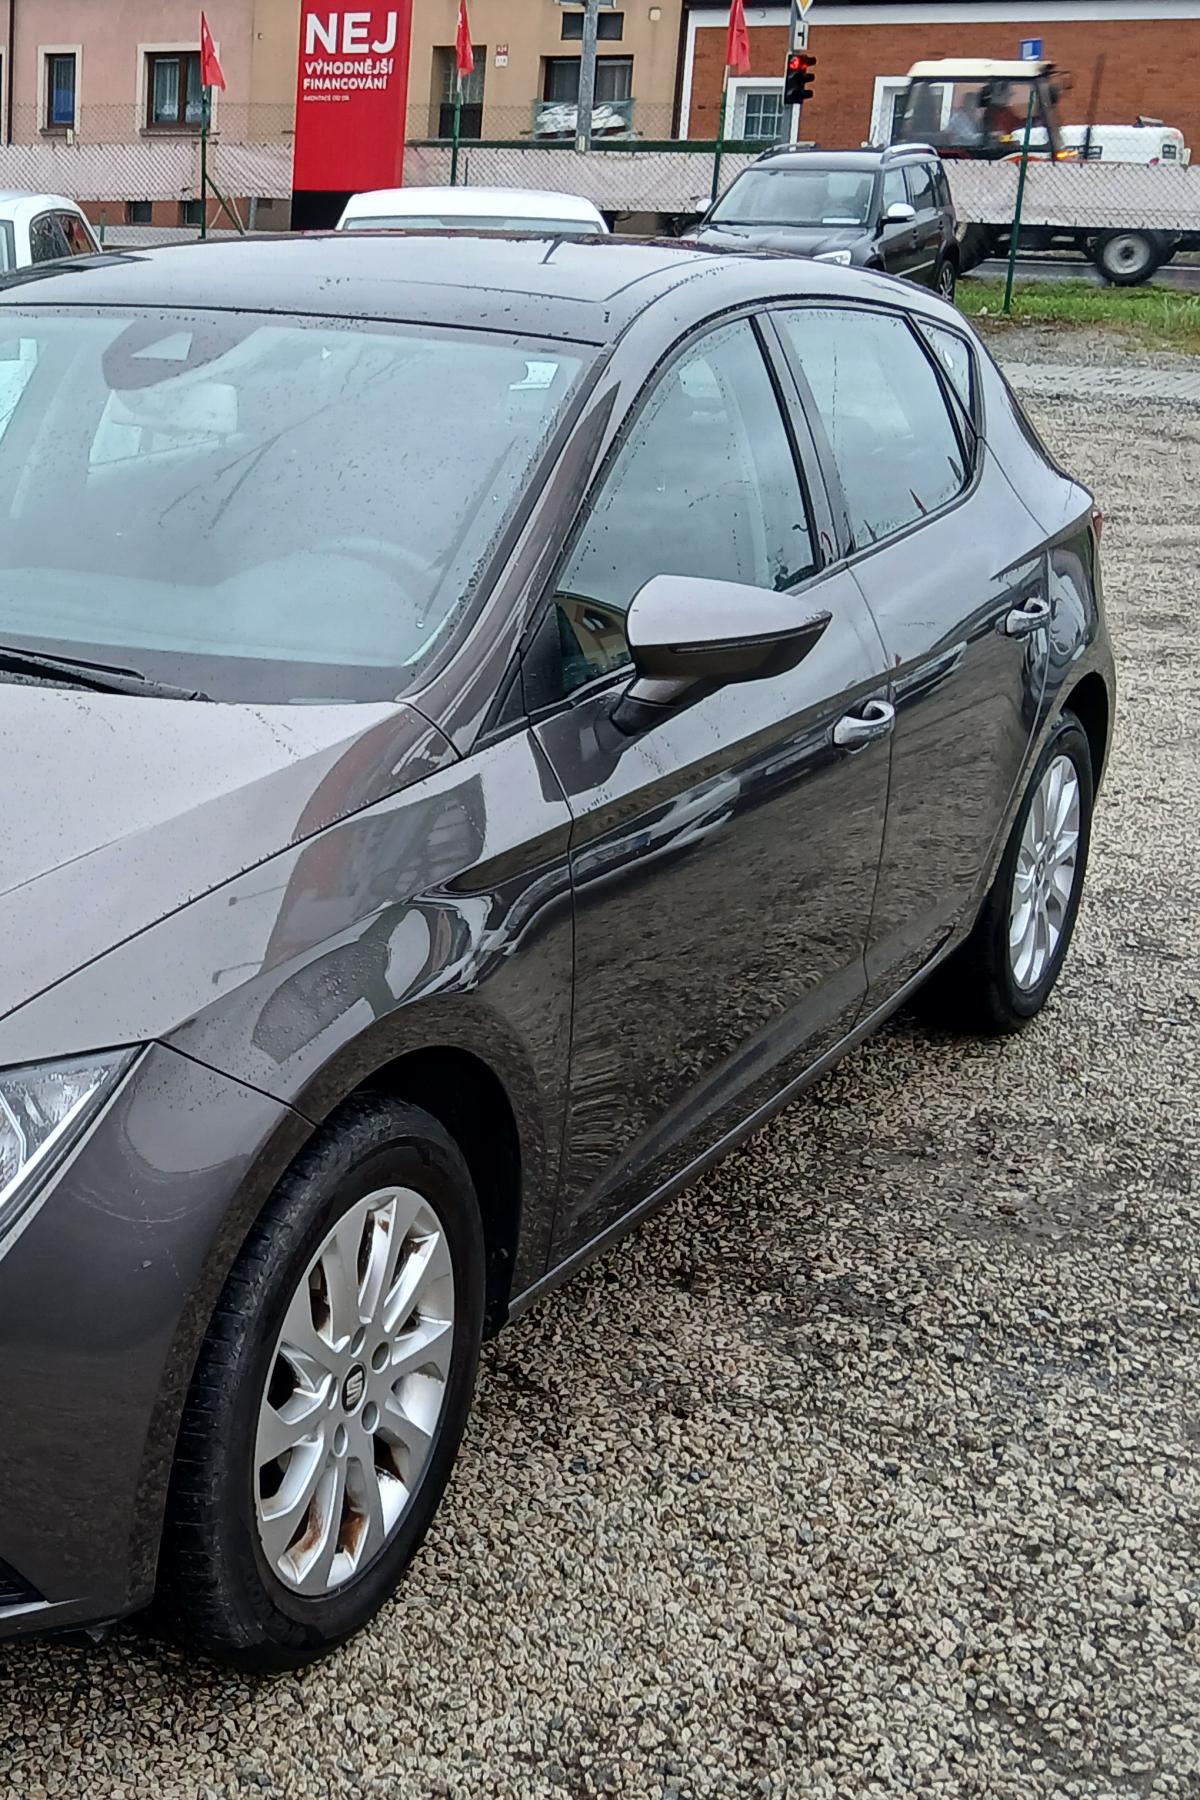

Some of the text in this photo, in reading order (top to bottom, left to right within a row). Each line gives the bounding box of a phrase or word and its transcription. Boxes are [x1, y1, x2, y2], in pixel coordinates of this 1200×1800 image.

[305, 11, 398, 54] NEJ
[304, 57, 394, 75] VÝHODNĚJŠÍ
[303, 75, 387, 90] FINANCOVÁNÍ
